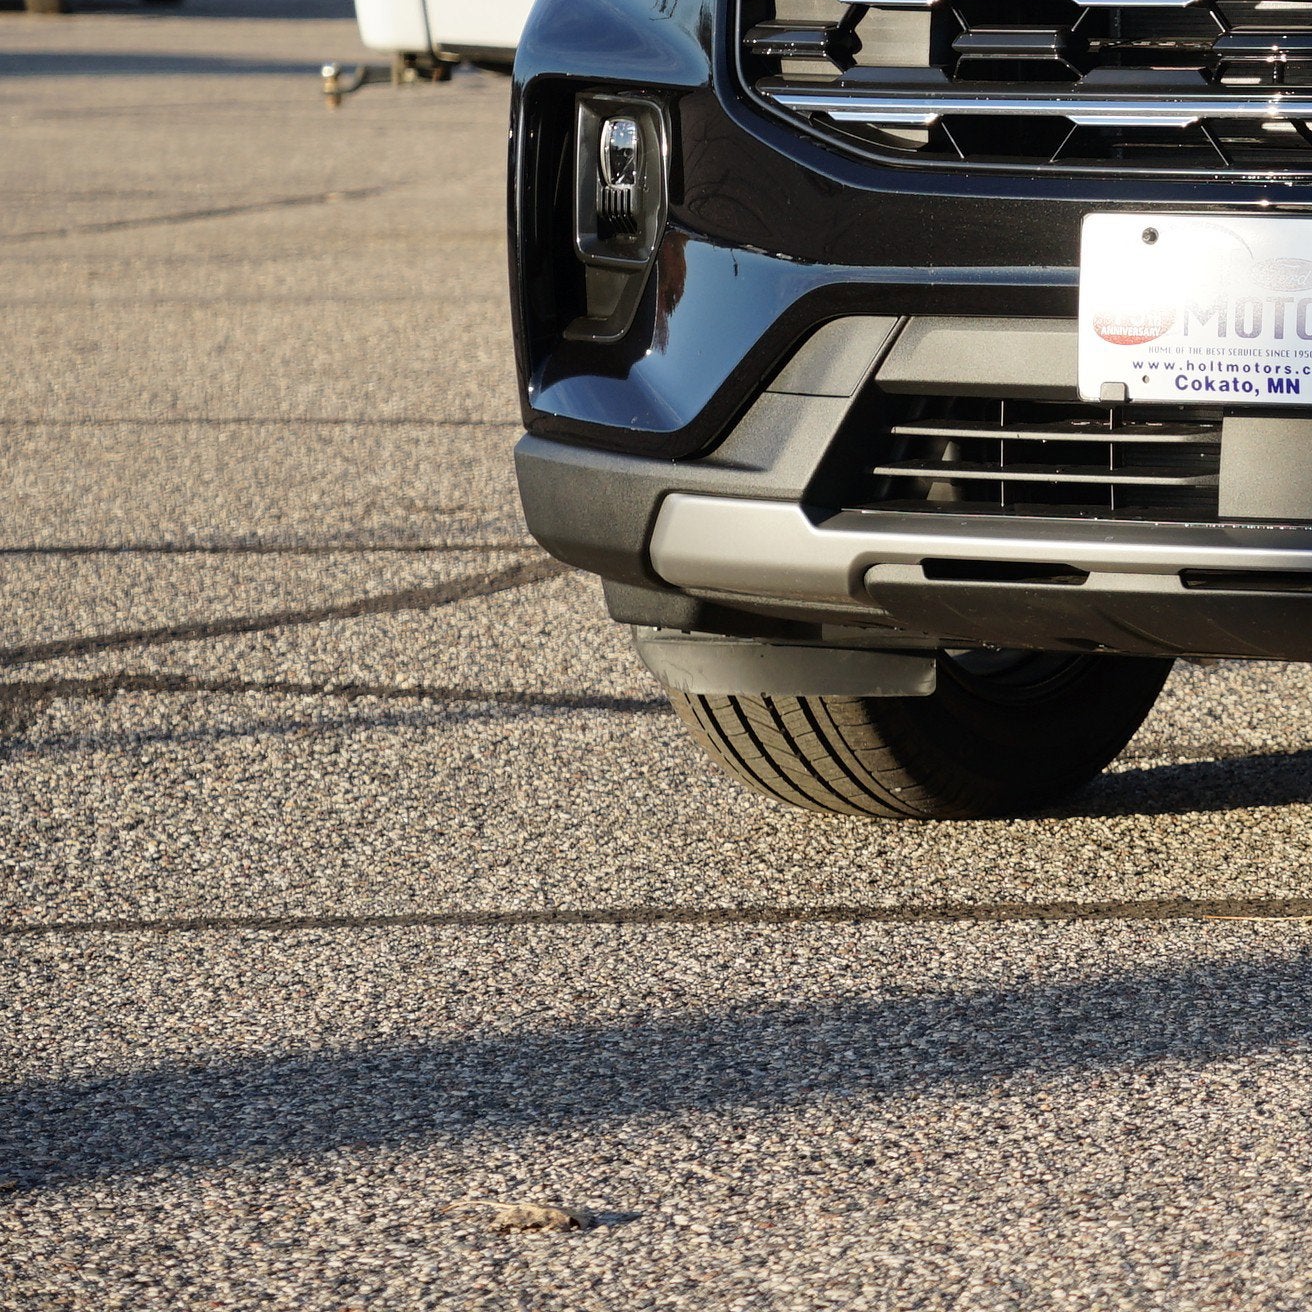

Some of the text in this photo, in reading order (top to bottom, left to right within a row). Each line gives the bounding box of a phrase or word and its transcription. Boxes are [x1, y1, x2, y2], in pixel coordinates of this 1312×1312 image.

[1101, 324, 1162, 337] ANNIVERSARY
[1175, 347, 1185, 355] OF
[1189, 347, 1202, 355] THE
[1206, 348, 1226, 356] BEST
[1228, 348, 1264, 357] SERVICE
[1265, 349, 1290, 358] SINCE
[1175, 374, 1301, 397] Cokato, MN
